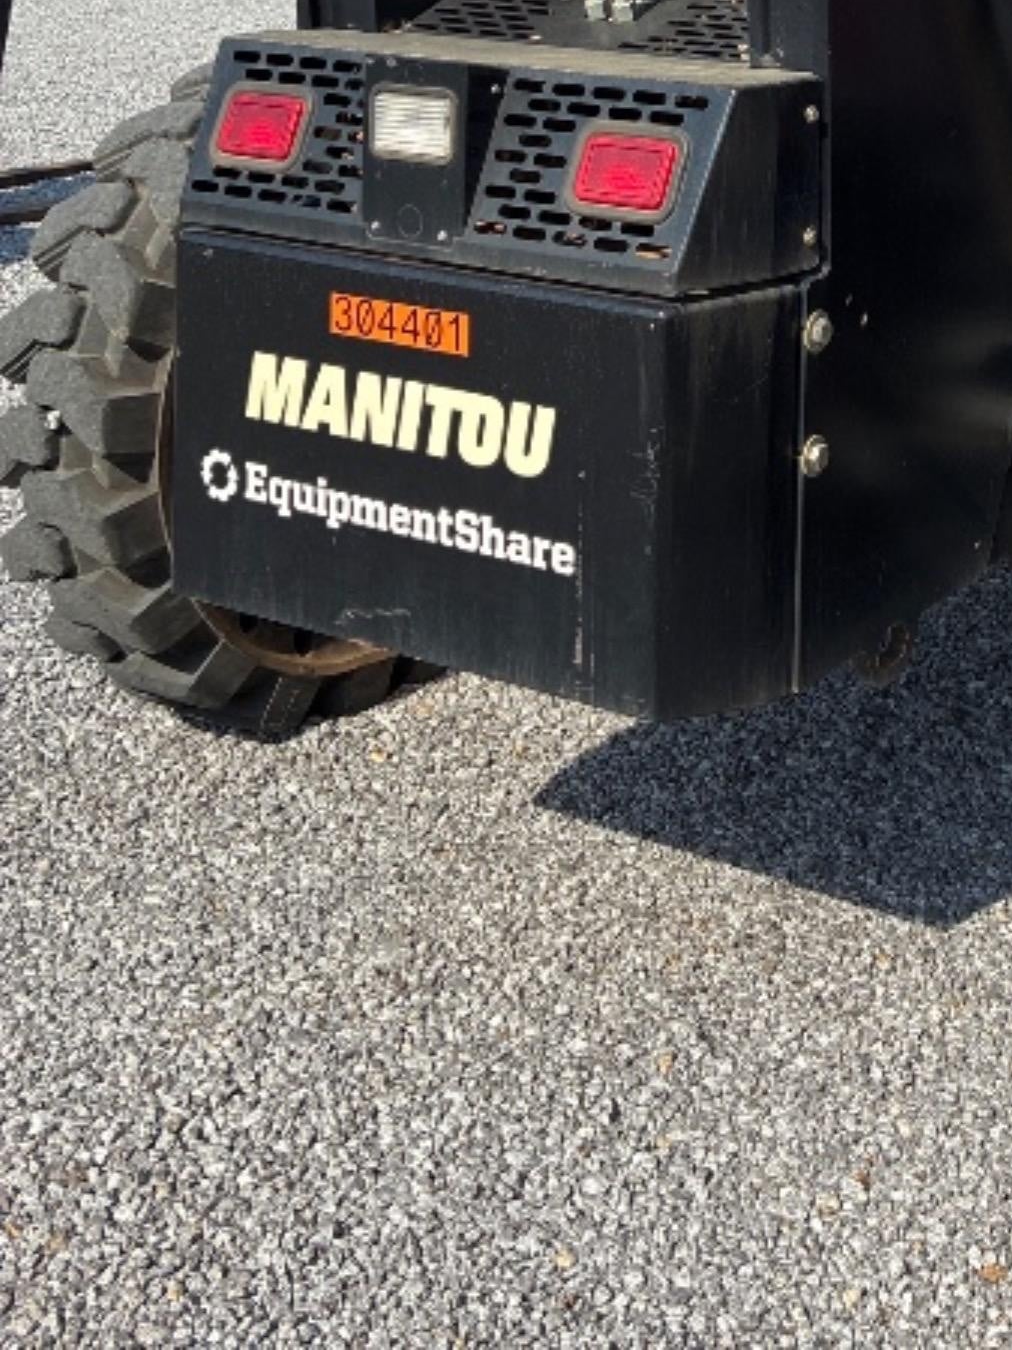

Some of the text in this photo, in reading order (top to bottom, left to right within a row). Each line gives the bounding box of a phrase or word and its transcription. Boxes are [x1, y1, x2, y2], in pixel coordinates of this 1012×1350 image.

[334, 296, 462, 352] 304401
[244, 350, 556, 479] MANITOU
[243, 461, 577, 577] EquipmentShare
